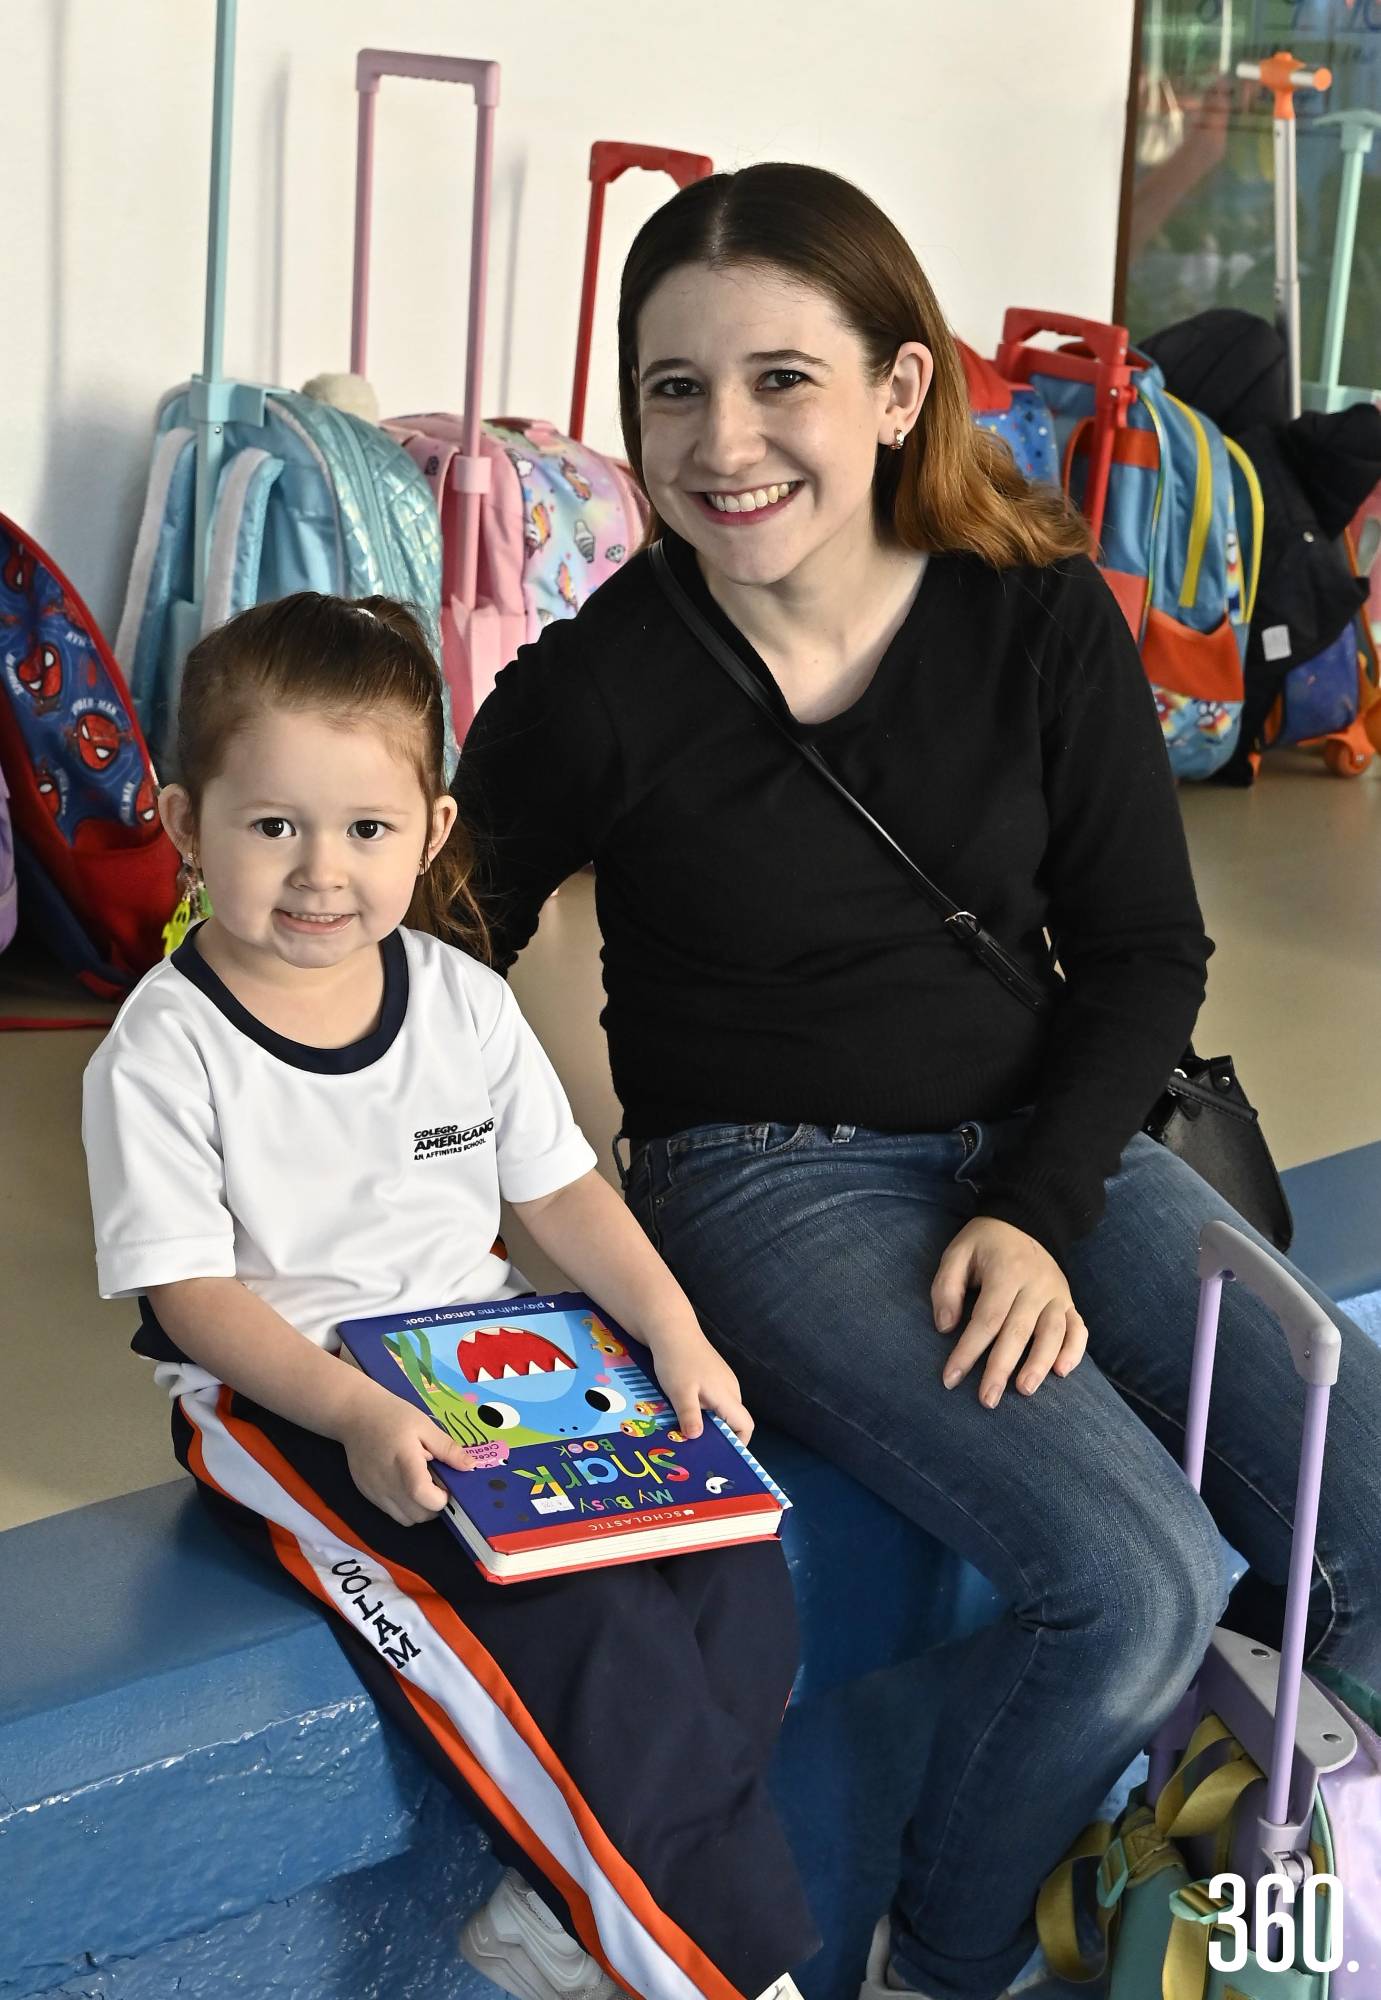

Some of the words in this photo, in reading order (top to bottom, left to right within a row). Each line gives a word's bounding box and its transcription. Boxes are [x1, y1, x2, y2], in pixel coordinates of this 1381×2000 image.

[414, 1125, 458, 1138] COLEGIO
[414, 1121, 494, 1153] AMERICANO
[426, 1147, 462, 1159] AFFINITAS
[463, 1138, 486, 1151] SCHOOL
[476, 1301, 545, 1315] play-with-me
[546, 1301, 555, 1309] A
[403, 1316, 433, 1326] book
[435, 1310, 476, 1321] sensory
[588, 1510, 682, 1531] SCHOLASTIC
[332, 1559, 421, 1669] COLAM
